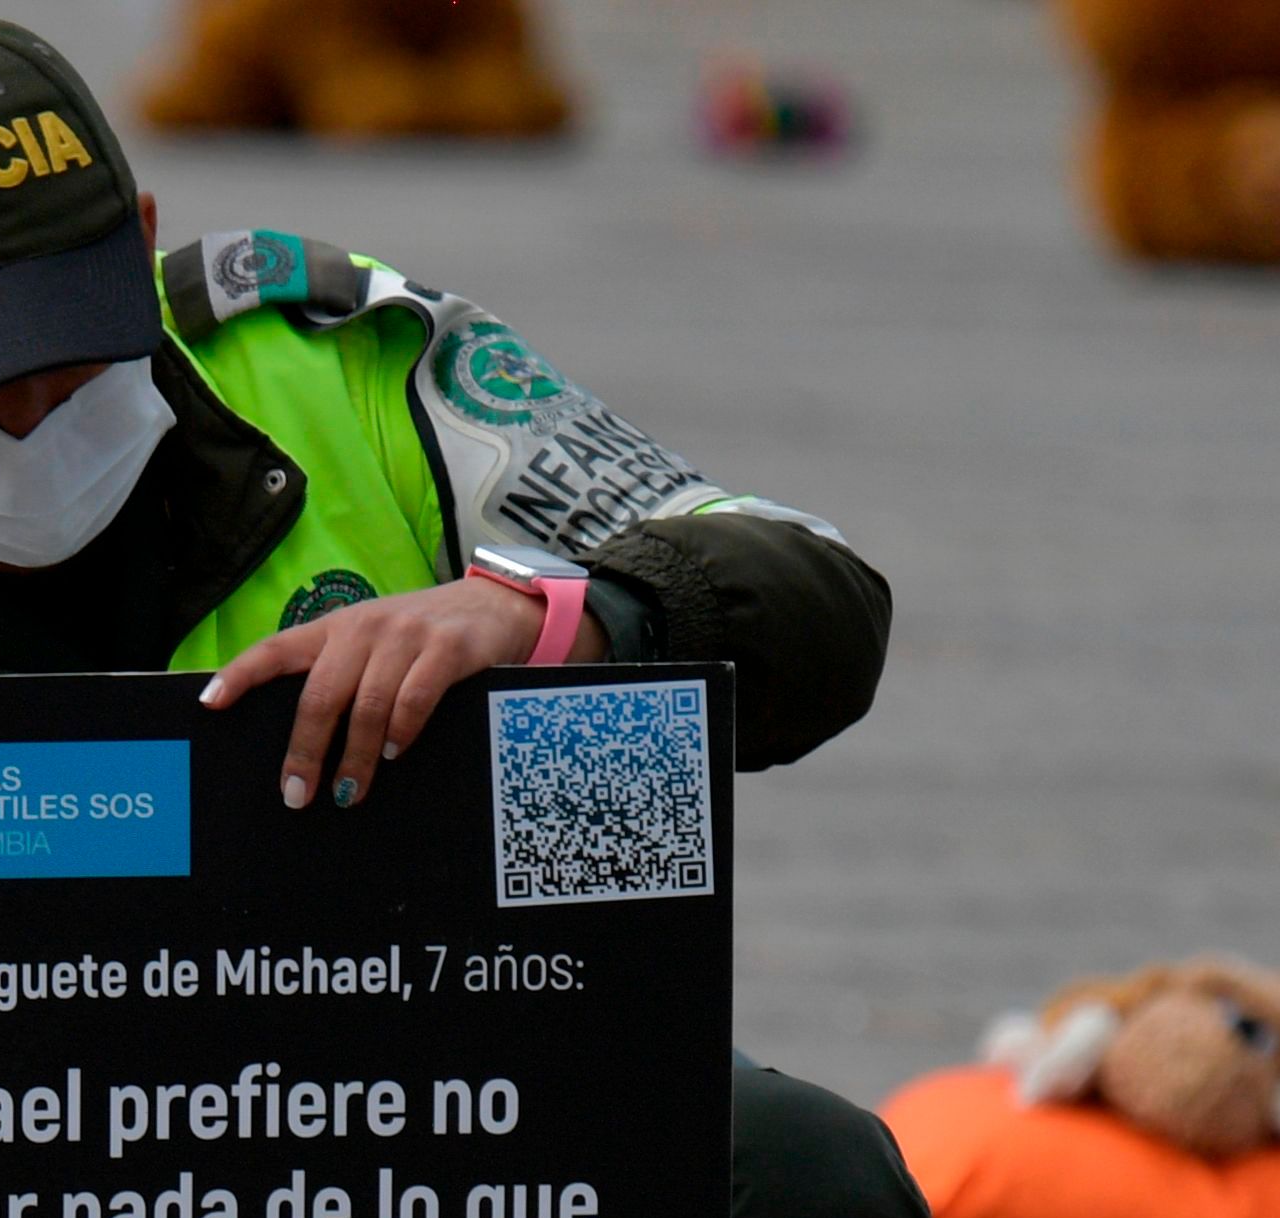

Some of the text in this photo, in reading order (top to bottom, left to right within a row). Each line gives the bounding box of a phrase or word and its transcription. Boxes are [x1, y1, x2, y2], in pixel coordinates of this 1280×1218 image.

[89, 792, 154, 819] SOS
[144, 949, 198, 997] de
[217, 945, 412, 1001] Michael,
[425, 945, 448, 992] 7
[464, 944, 584, 992] años:
[109, 1062, 406, 1158] prefiere
[433, 1076, 519, 1135] no
